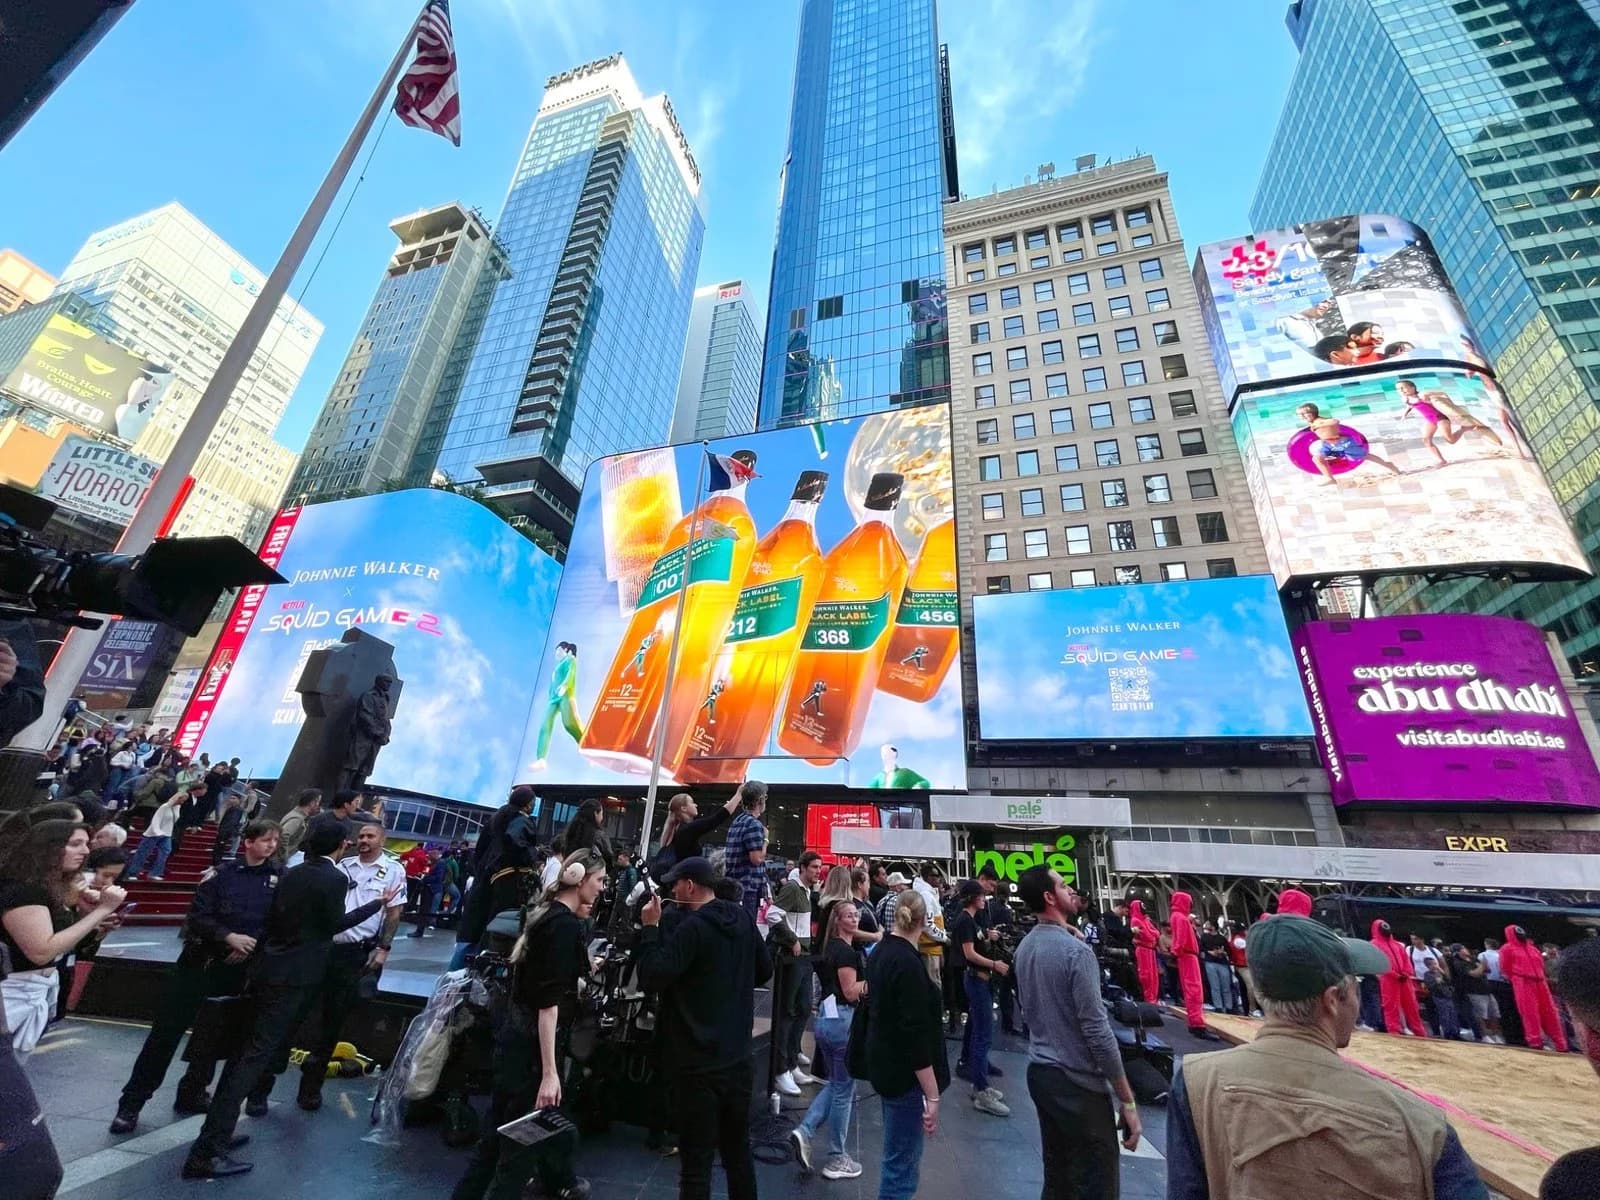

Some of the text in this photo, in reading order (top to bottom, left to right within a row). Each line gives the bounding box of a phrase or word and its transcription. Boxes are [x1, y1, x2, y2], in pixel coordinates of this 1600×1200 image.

[1232, 270, 1286, 289] Sandy
[720, 287, 742, 300] RIU
[71, 446, 139, 470] LITTLE
[289, 560, 441, 588] JOHNNIE WALKER
[260, 603, 444, 637] SQUID GAME 2
[839, 611, 878, 621] LABEL
[920, 610, 956, 623] 456
[817, 629, 850, 645] 368
[1065, 621, 1182, 638] JOHNNIE WALKER
[1060, 647, 1118, 668] SQUID
[1122, 648, 1182, 666] GAME
[1353, 661, 1477, 682] experience
[620, 683, 633, 697] 12
[1356, 681, 1453, 713] abu
[1300, 645, 1343, 783] visitabudhabi.ae
[694, 725, 706, 740] 12
[1396, 729, 1566, 750] visitabudhabi.ae
